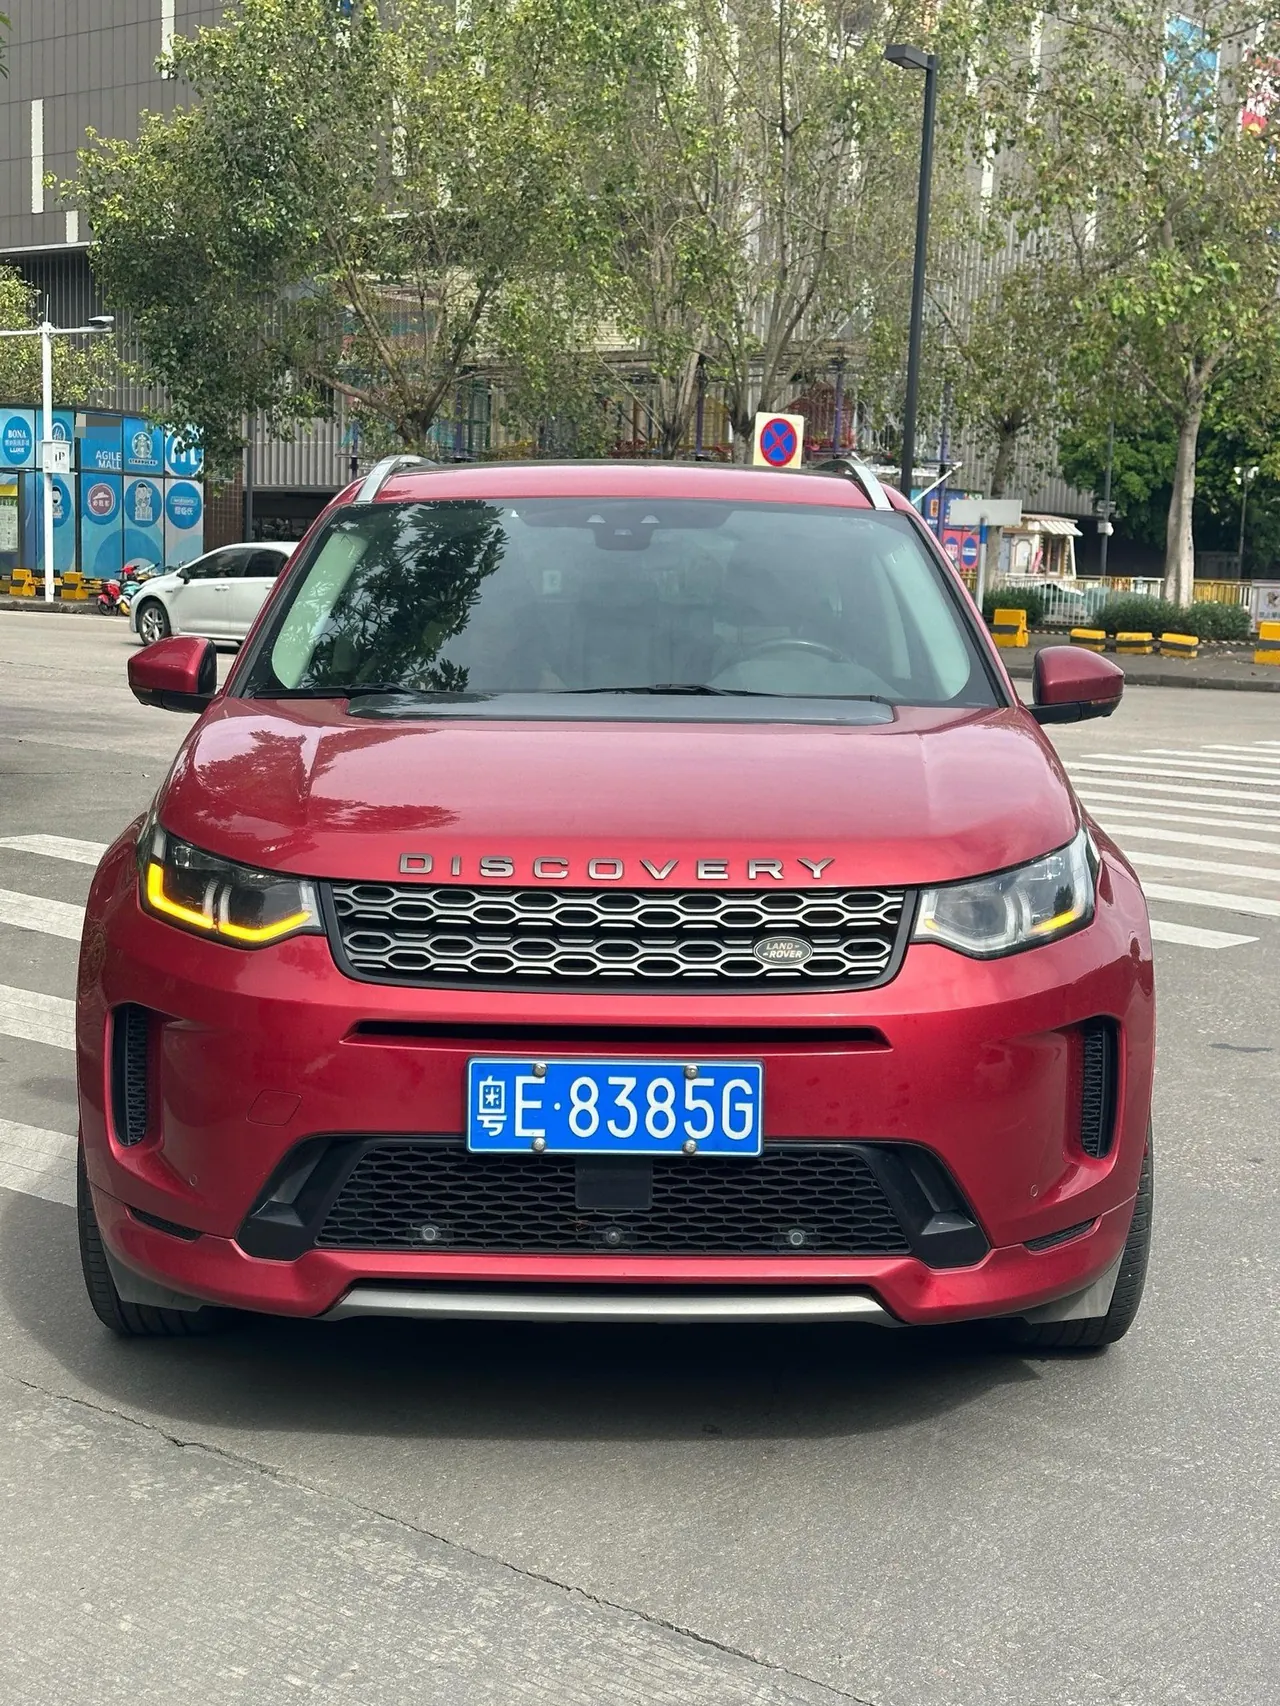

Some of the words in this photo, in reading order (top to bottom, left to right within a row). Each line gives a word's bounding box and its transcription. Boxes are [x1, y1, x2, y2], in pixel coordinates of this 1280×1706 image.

[7, 429, 27, 439] BONA
[95, 450, 122, 461] AGILE
[98, 459, 122, 470] MALL
[398, 852, 836, 880] DISCOVERY
[766, 942, 794, 951] LAND
[769, 950, 803, 958] ROVER
